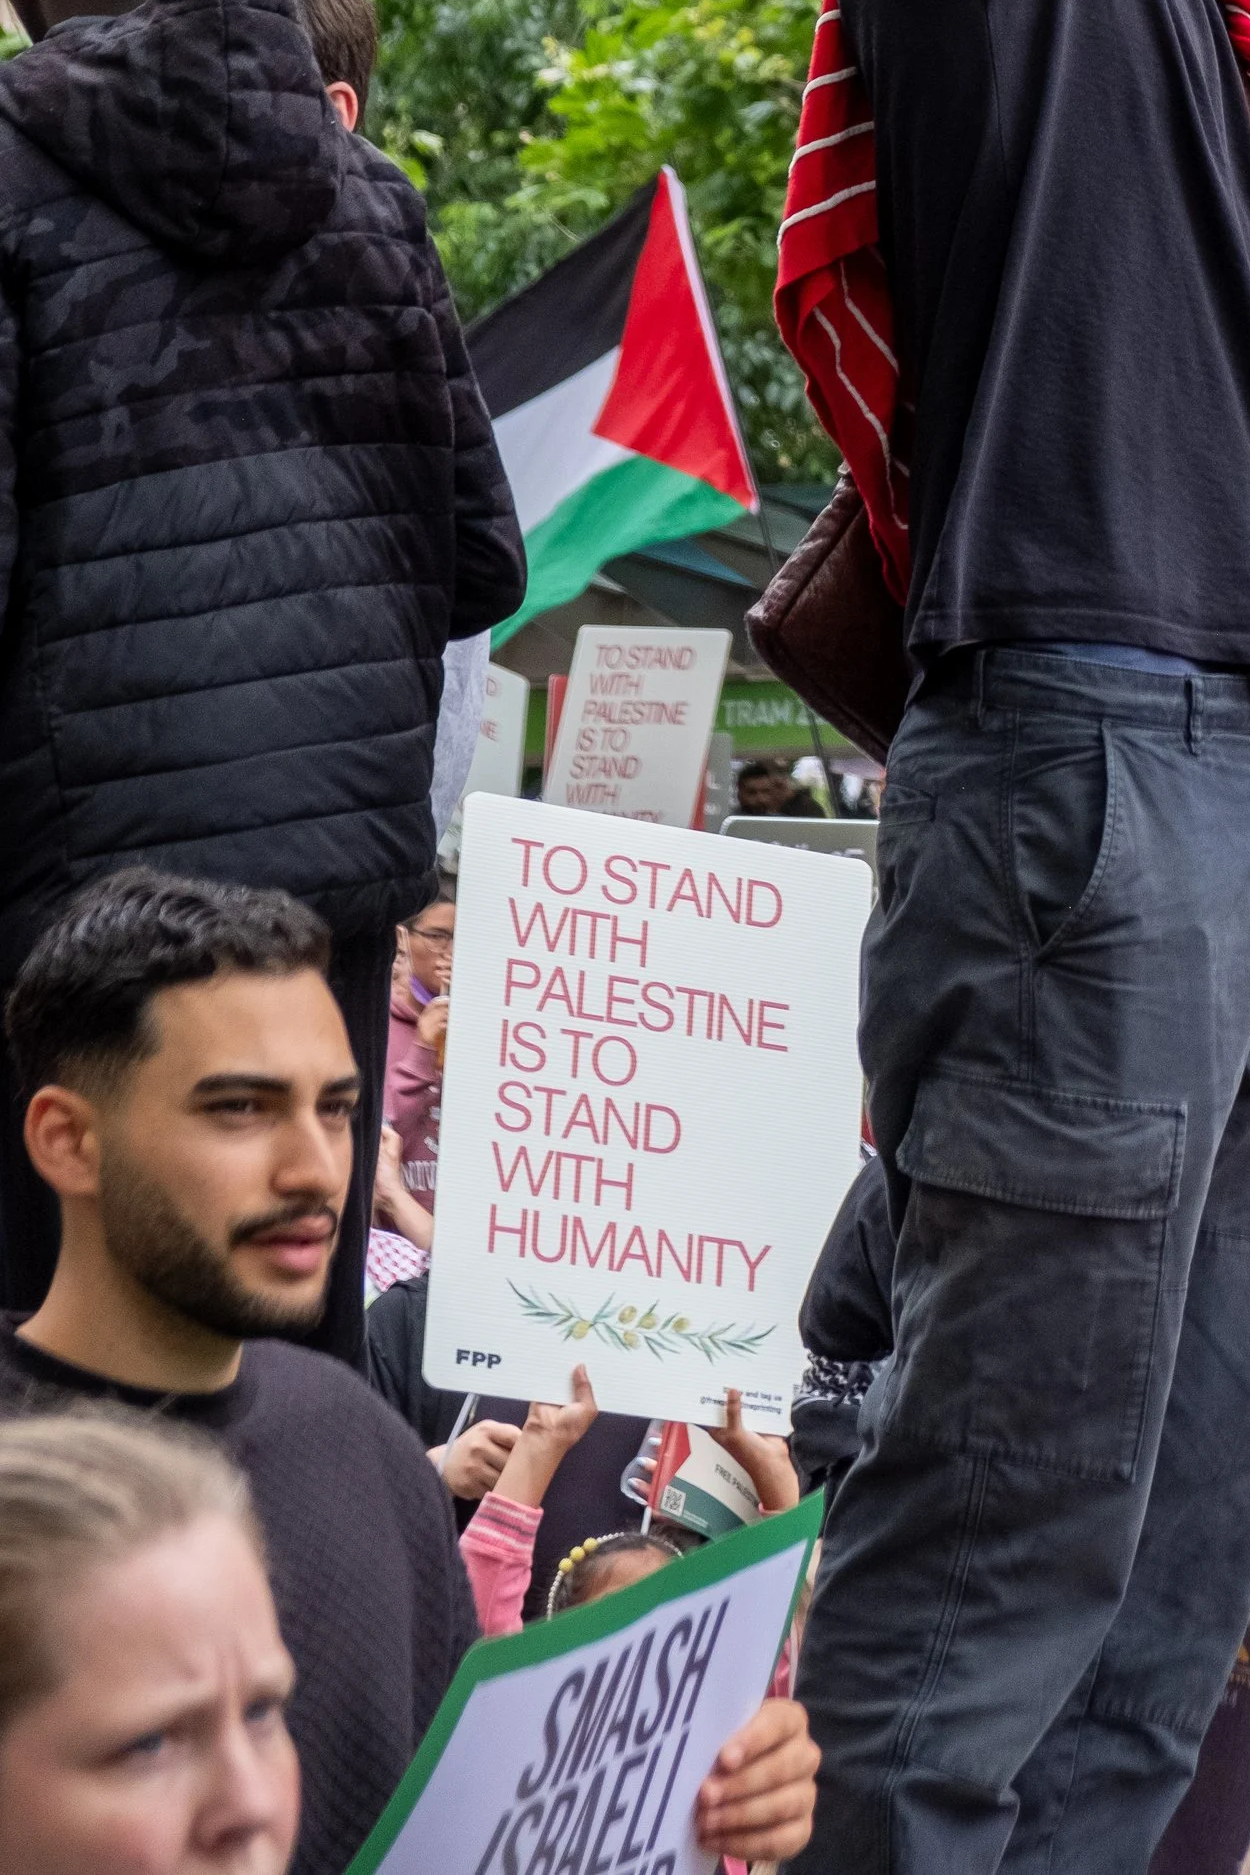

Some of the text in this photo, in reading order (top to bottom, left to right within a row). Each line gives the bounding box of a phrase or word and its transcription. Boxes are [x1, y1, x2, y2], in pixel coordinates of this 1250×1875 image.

[596, 644, 697, 671] TO STAND
[589, 672, 643, 696] WITH
[580, 700, 690, 725] PALESTINE
[721, 699, 795, 727] TRAM
[575, 727, 632, 752] IS TO
[568, 755, 643, 780] STAND
[565, 782, 622, 807] WITH
[511, 837, 783, 929] TO STAND
[508, 896, 649, 968] WITH
[504, 958, 790, 1053] PALESTINE
[499, 1019, 637, 1087] IS TO
[494, 1080, 682, 1154] STAND
[491, 1140, 635, 1211] WITH
[487, 1203, 773, 1293] HUMANITY
[455, 1348, 502, 1370] FPP
[516, 1597, 731, 1801] SMASH
